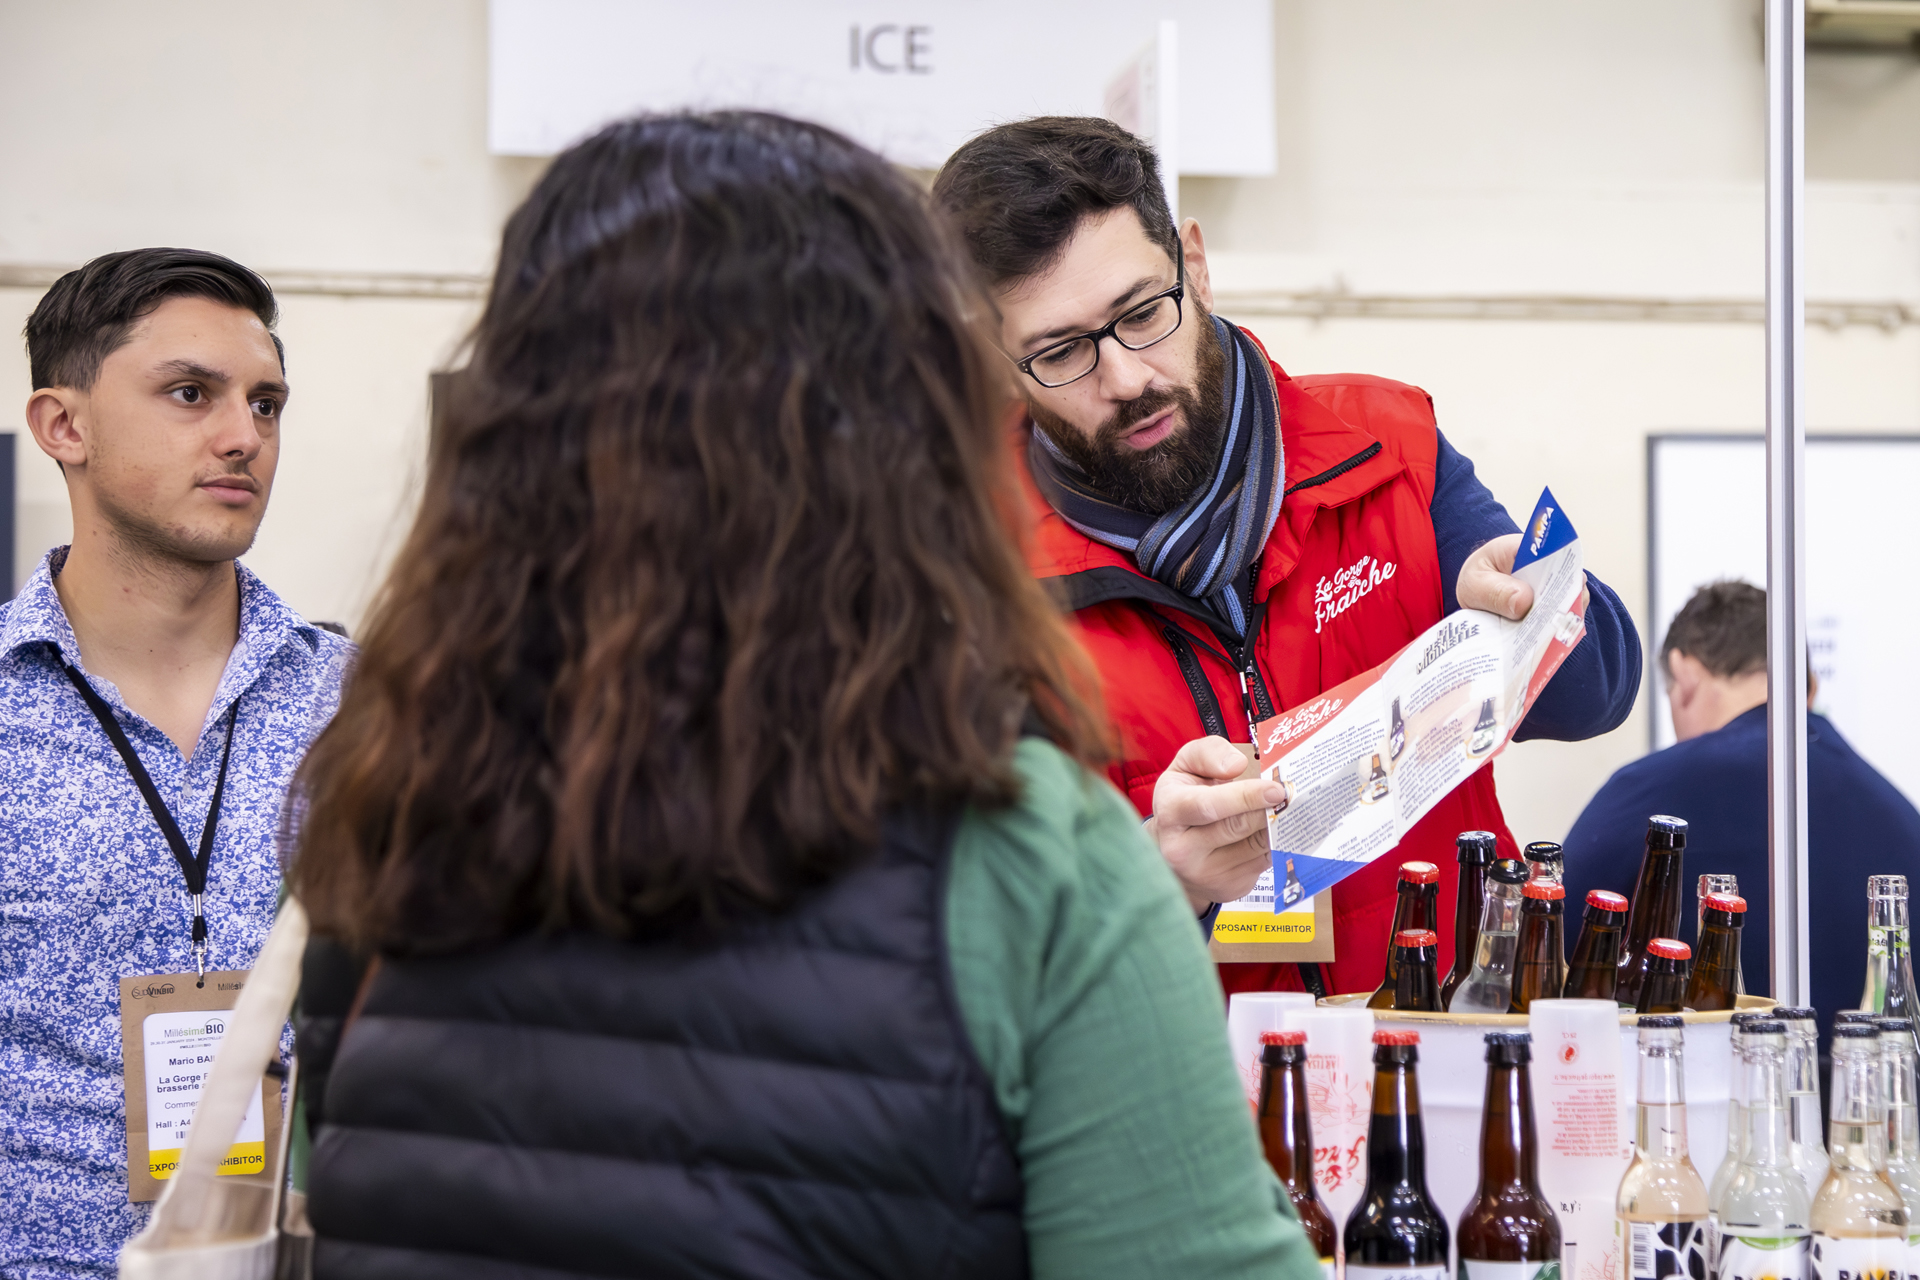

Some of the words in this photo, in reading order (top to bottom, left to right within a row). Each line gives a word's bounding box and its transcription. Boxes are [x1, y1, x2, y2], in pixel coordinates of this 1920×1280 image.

[849, 24, 934, 75] ICE
[1530, 506, 1555, 557] PAMPA
[1315, 575, 1334, 606] La
[1333, 555, 1371, 594] Gorge
[1265, 925, 1312, 933] EXHIBITOR
[169, 1057, 195, 1066] Mario
[172, 1075, 201, 1084] Gorge
[157, 1083, 200, 1093] brasserie
[156, 1120, 173, 1129] Hall
